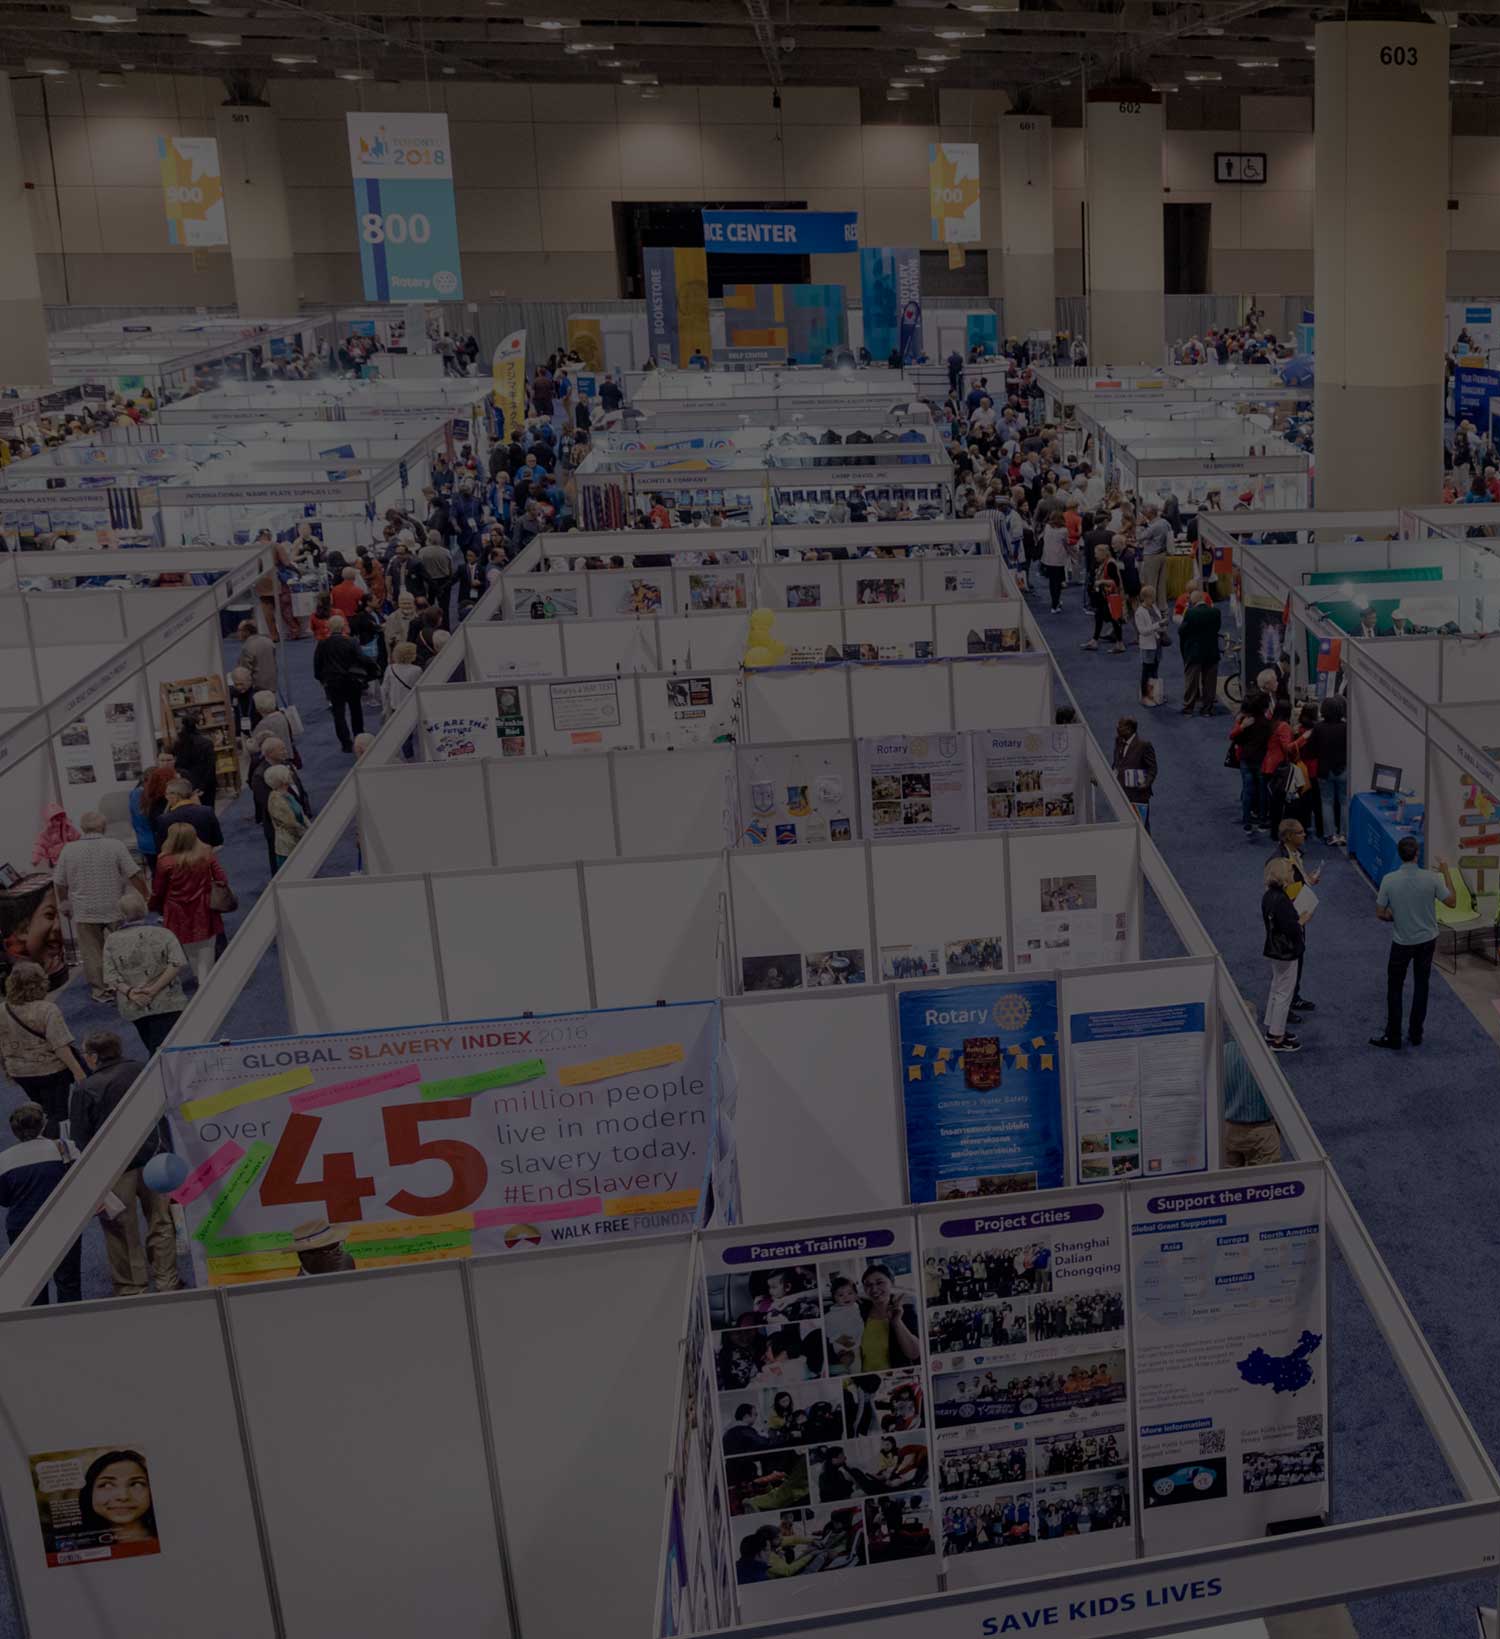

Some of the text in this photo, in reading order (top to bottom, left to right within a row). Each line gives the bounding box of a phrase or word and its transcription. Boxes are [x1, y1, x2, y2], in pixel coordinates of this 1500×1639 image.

[1380, 46, 1418, 66] 603
[1119, 103, 1141, 113] 602
[393, 149, 446, 165] 2018
[361, 213, 431, 245] 800
[727, 223, 797, 243] CENTER
[392, 276, 431, 290] Rotary
[651, 268, 665, 335] BOOKSTORE
[443, 719, 465, 729] ARE
[877, 743, 907, 755] Rotary
[992, 739, 1022, 749] Rotary
[925, 1008, 988, 1026] Rotary
[242, 1048, 341, 1070] GLOBAL
[348, 1037, 453, 1061] SLAVERY
[461, 1030, 532, 1050] INDEX
[538, 1025, 589, 1045] 2016
[494, 1075, 705, 1115] million people
[199, 1119, 273, 1144] Over
[497, 1108, 706, 1145] live in modern
[259, 1097, 489, 1224] 45
[500, 1137, 697, 1177] slavery today.
[504, 1169, 679, 1206] #EndSlavery
[1157, 1183, 1297, 1212] Support the Project
[551, 1224, 592, 1241] WALK
[595, 1217, 630, 1235] FREE
[975, 1209, 1071, 1232] Project Cities
[1132, 1217, 1224, 1234] Global Grant Supporters
[1218, 1236, 1247, 1245] Europe
[1261, 1227, 1318, 1240] North America
[750, 1235, 867, 1259] Parent Training
[1054, 1237, 1109, 1254] Shanghai
[1054, 1254, 1092, 1266] Dalian
[1055, 1261, 1121, 1280] Chongqing
[1217, 1272, 1254, 1284] Australia
[1141, 1427, 1162, 1436] More
[982, 1577, 1223, 1636] SAVE KIDS LIVES
